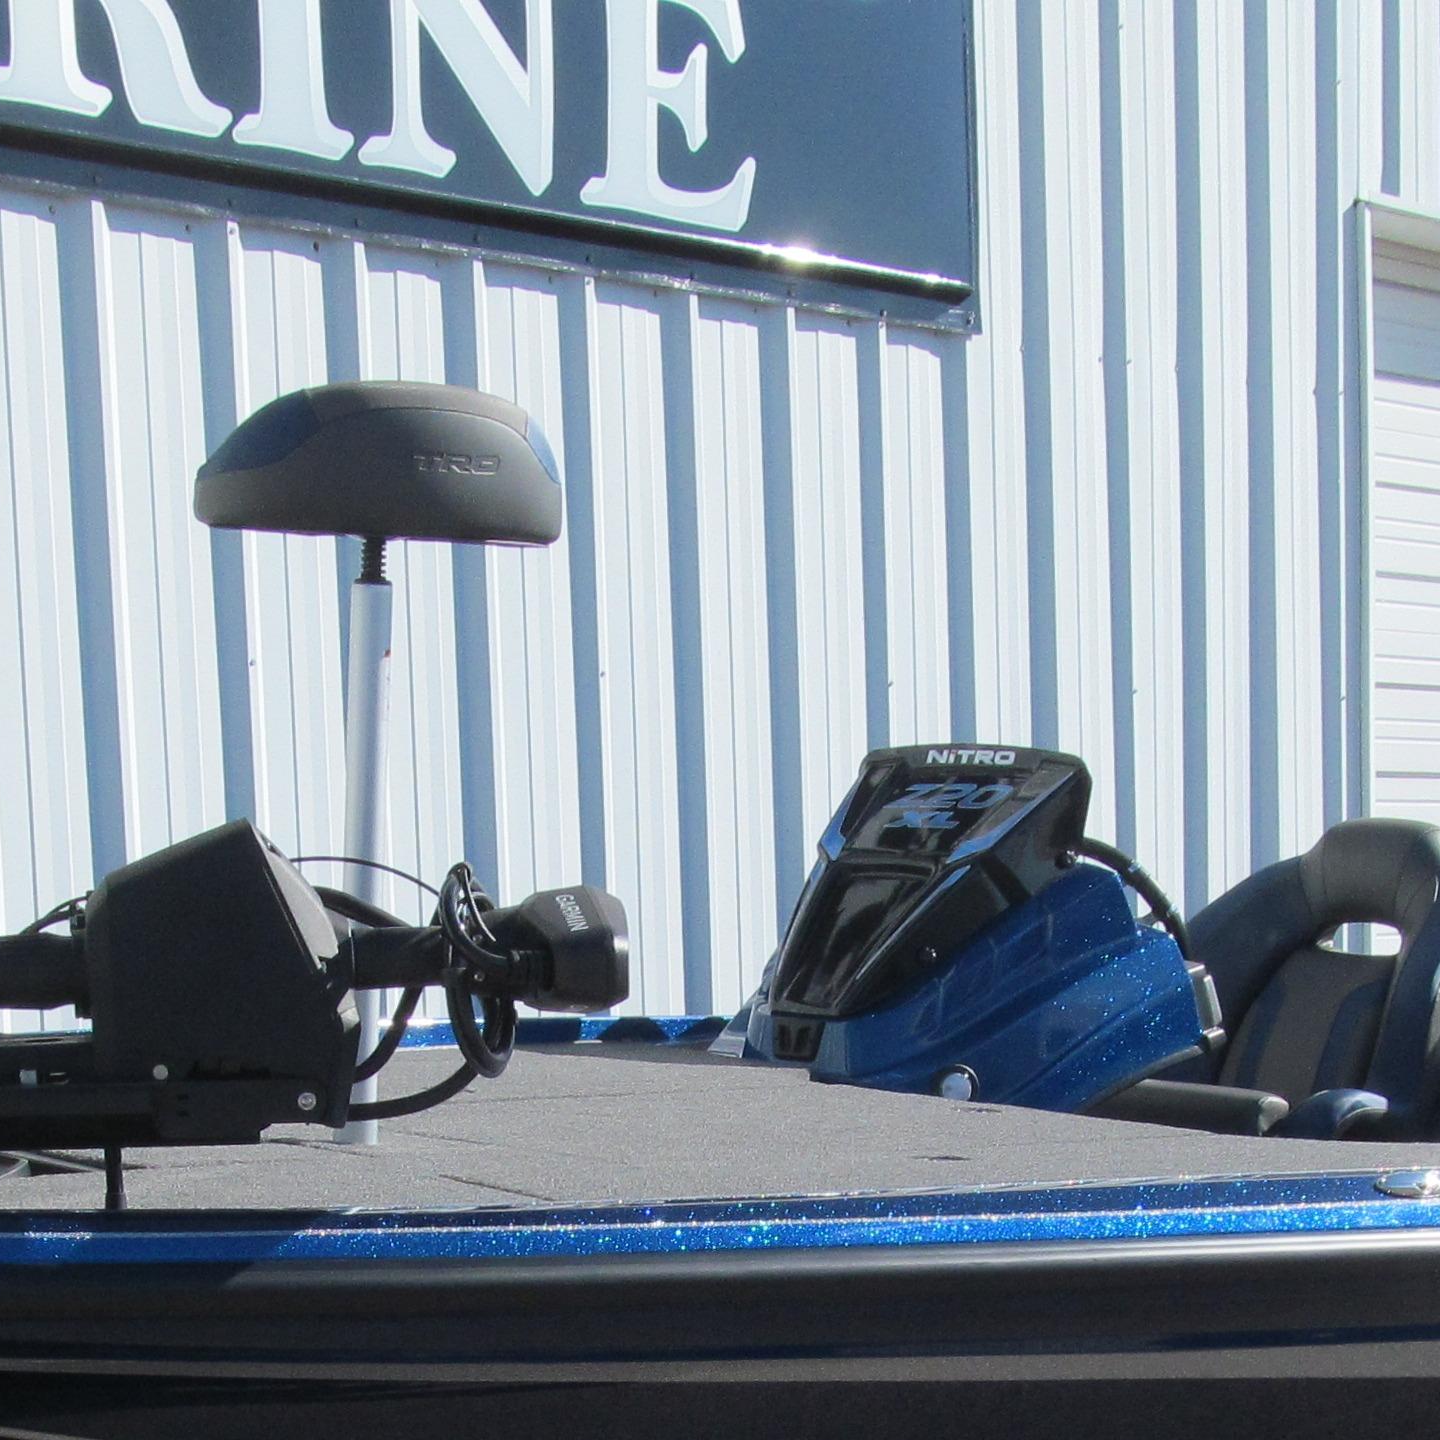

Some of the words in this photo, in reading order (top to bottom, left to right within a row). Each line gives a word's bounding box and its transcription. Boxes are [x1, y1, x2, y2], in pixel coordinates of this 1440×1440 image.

[926, 749, 1016, 766] NITRO
[882, 811, 960, 829] XL
[555, 894, 590, 932] GARMIN
